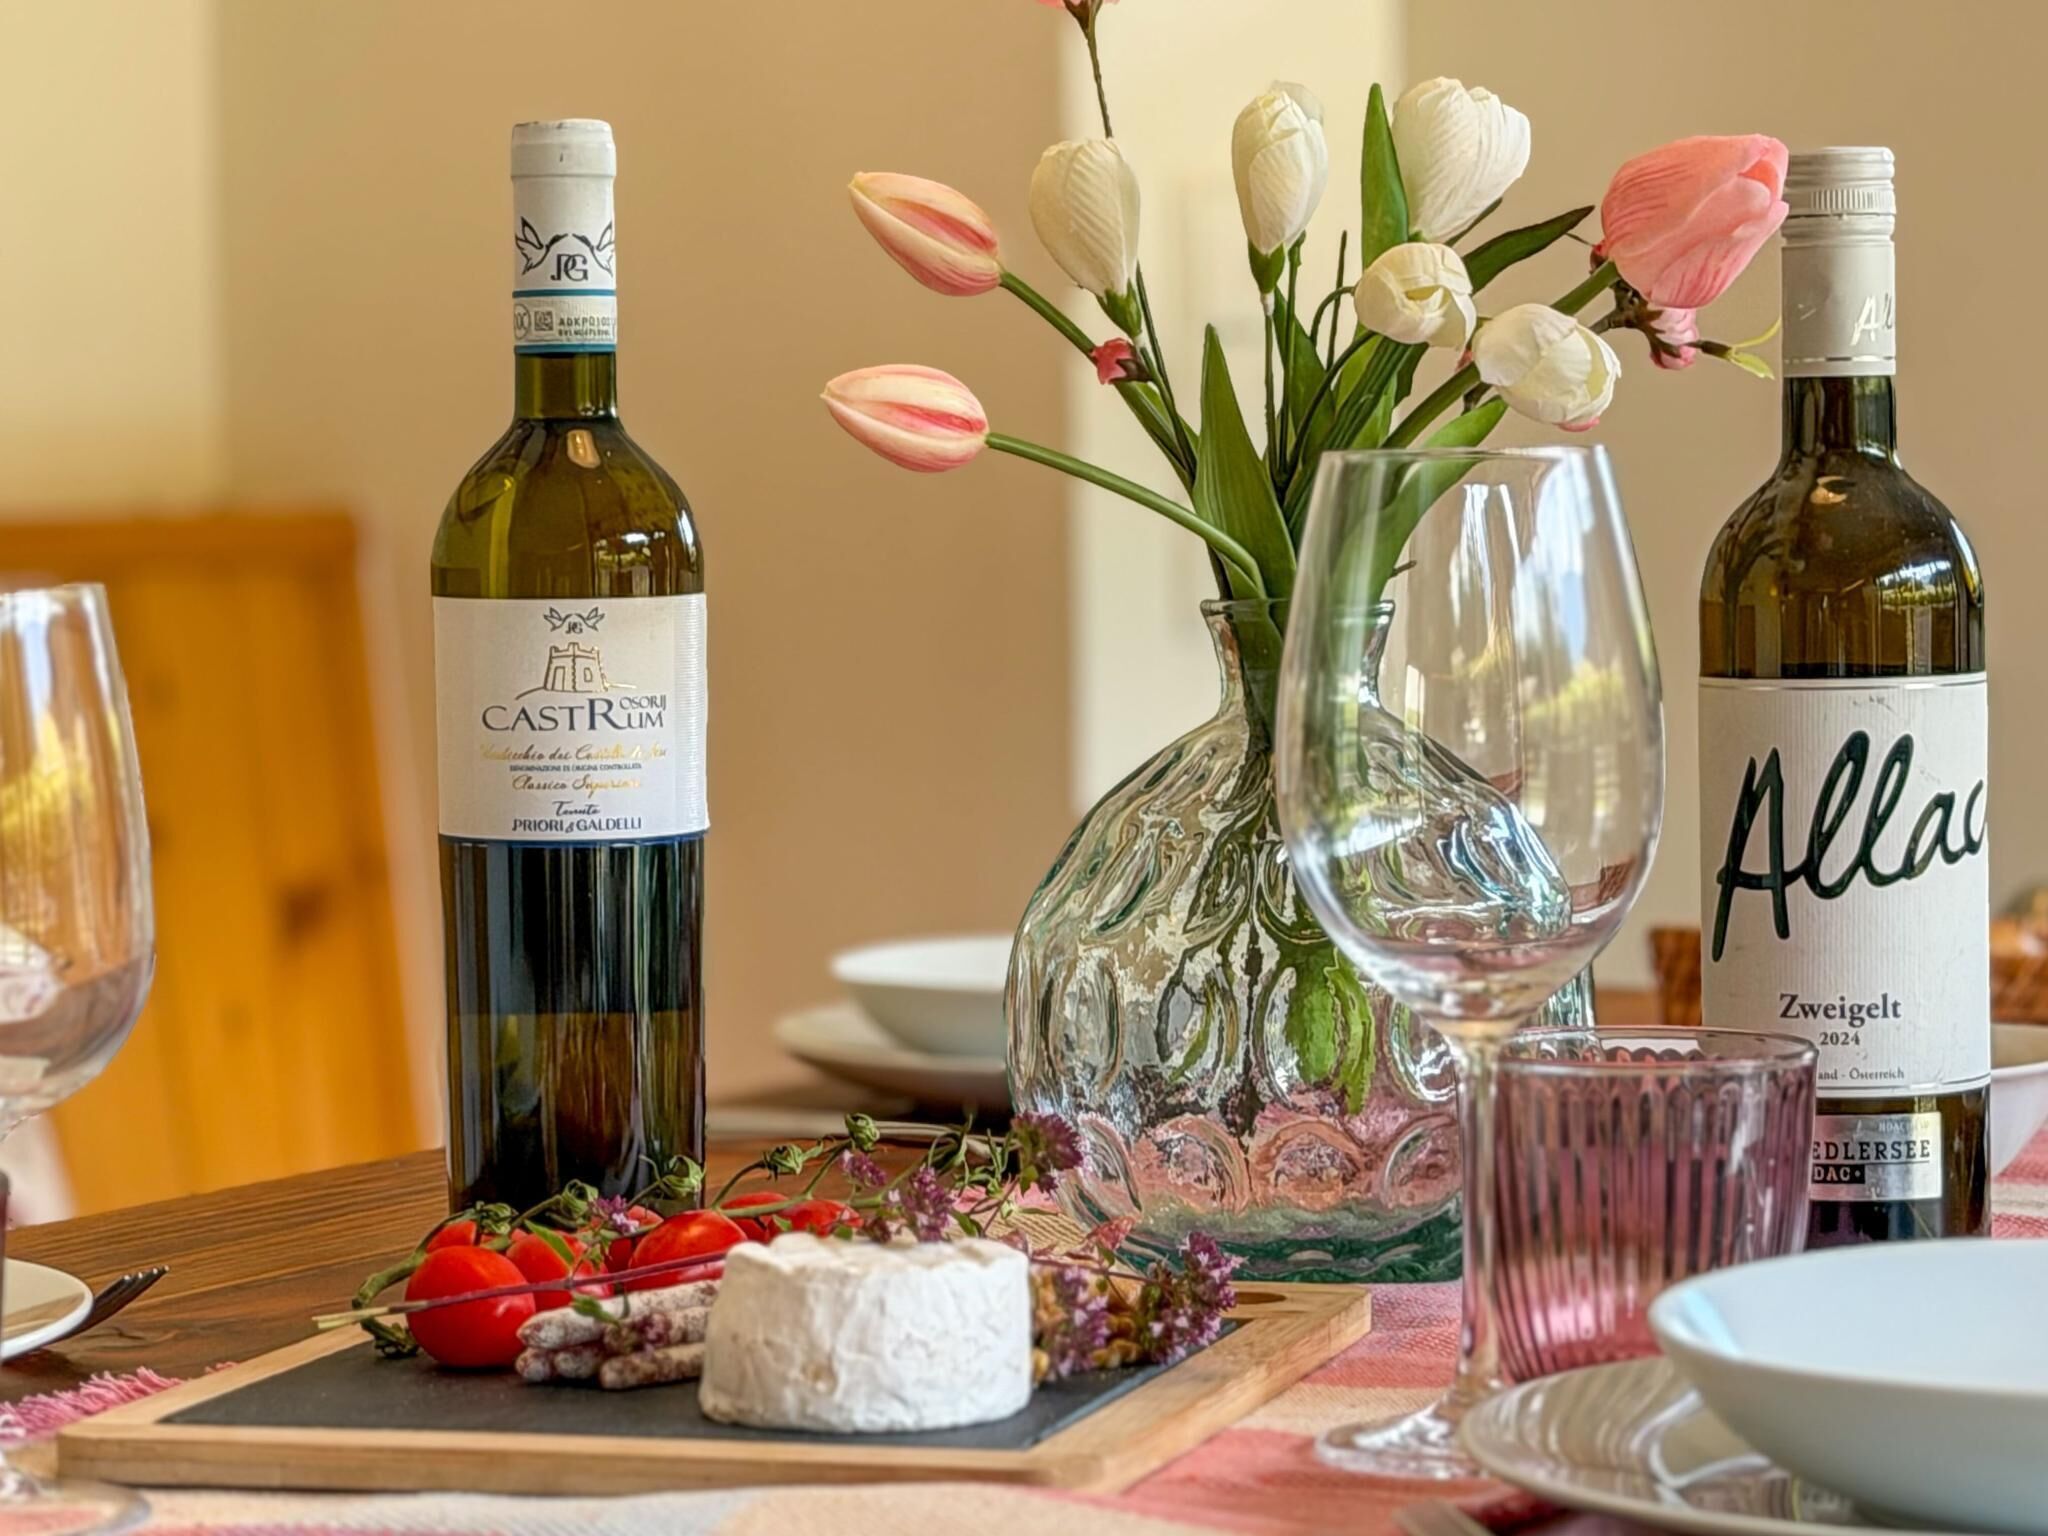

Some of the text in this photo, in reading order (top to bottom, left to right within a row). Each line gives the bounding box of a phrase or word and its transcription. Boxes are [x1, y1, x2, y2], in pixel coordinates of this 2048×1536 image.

[1779, 993, 1902, 1028] Zweigelt
[1819, 1031, 1861, 1046] 2024
[1849, 1067, 1905, 1081] Österreich
